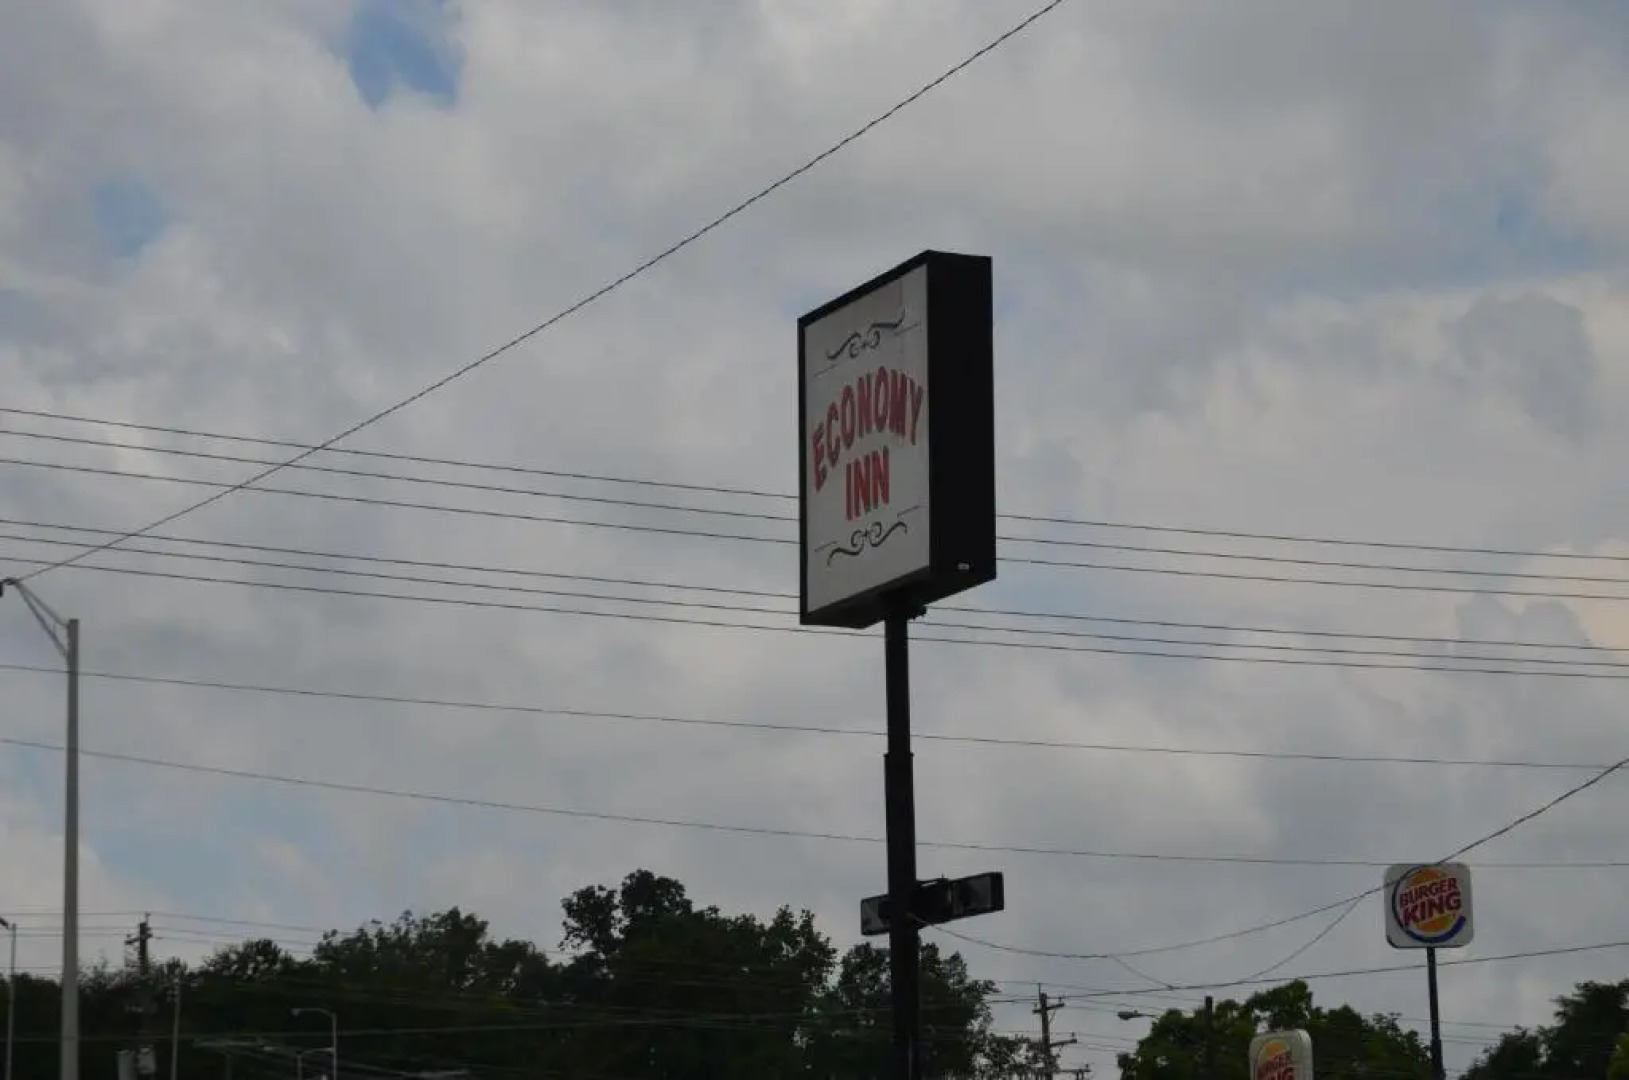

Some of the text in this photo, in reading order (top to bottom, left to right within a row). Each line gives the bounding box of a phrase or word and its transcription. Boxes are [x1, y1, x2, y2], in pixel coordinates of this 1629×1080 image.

[813, 366, 923, 493] ECONOMY
[846, 446, 890, 520] INN
[1400, 878, 1458, 908] BURGER
[1402, 891, 1461, 927] KING
